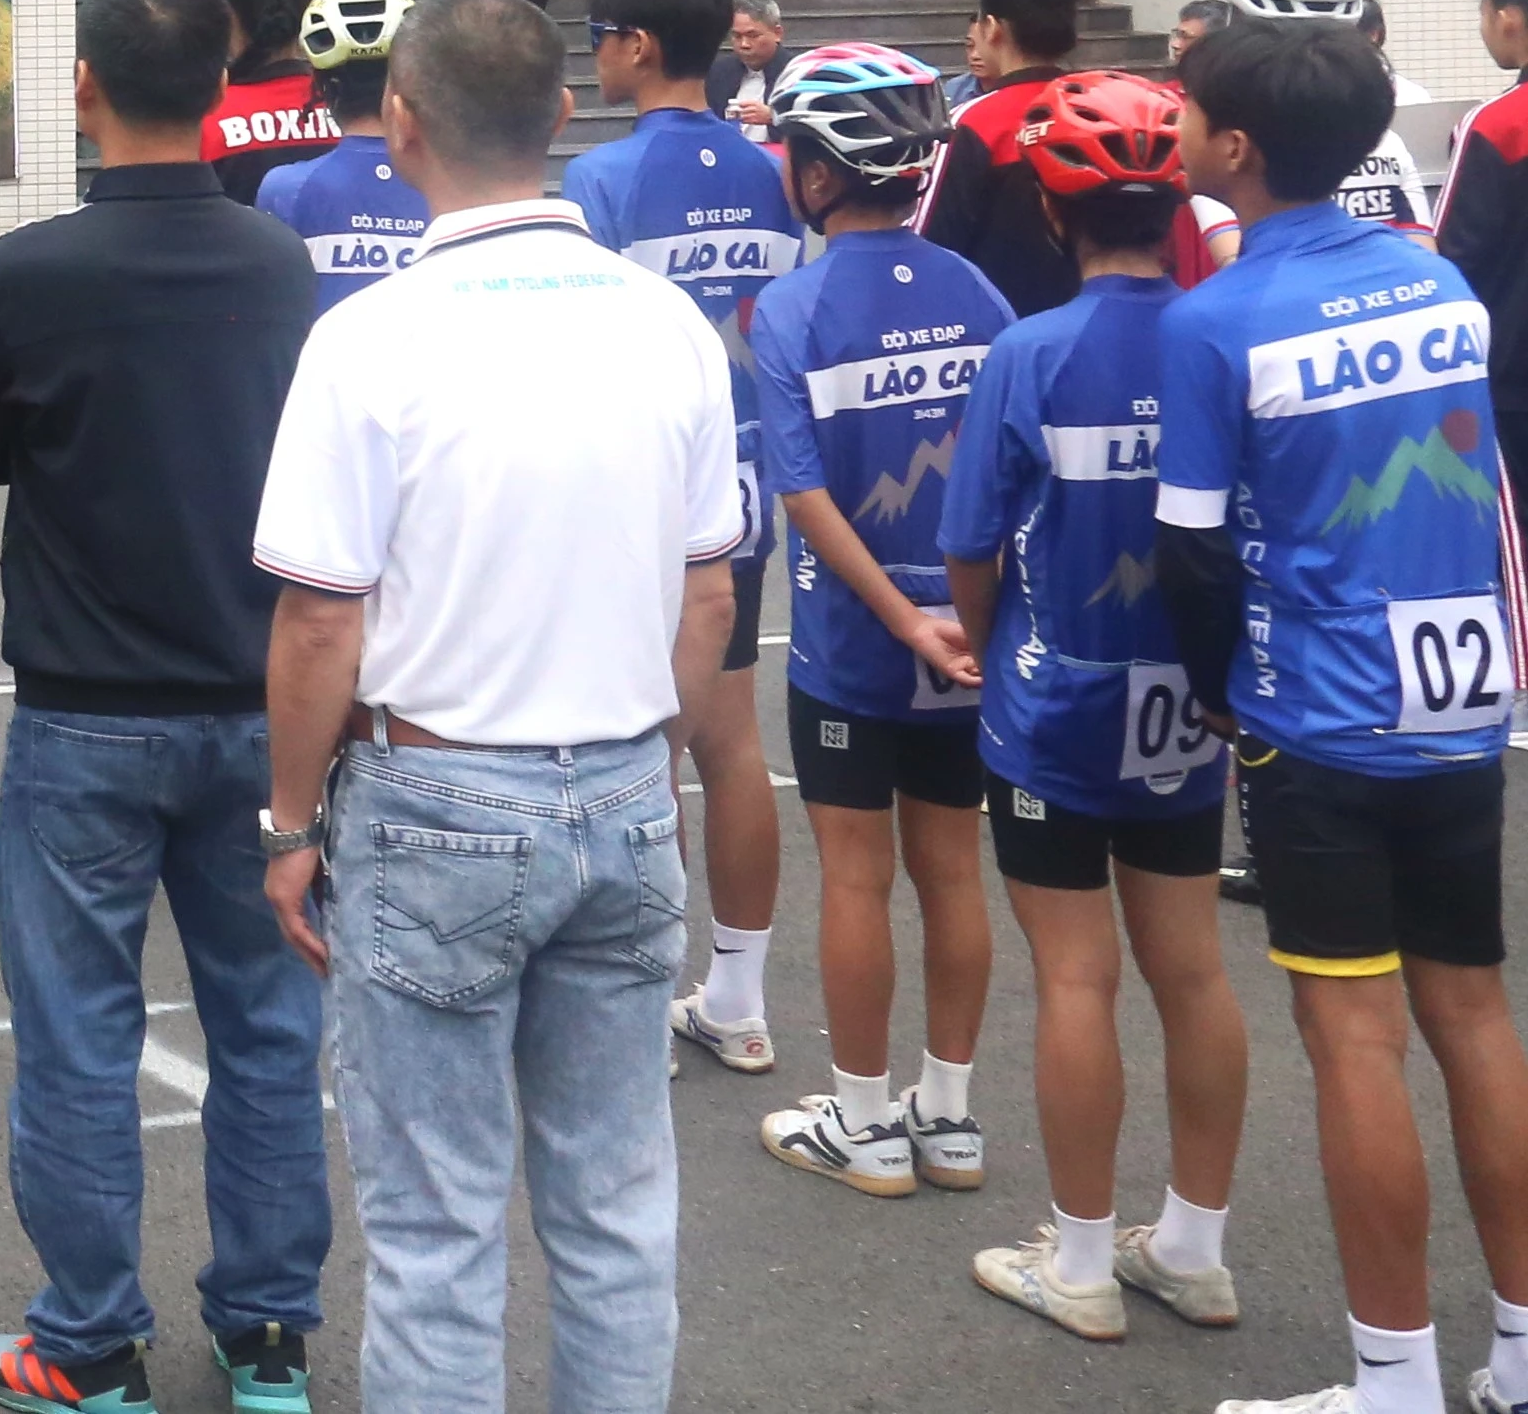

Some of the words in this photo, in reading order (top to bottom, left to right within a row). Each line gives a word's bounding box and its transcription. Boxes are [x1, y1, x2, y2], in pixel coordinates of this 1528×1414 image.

[219, 107, 343, 148] BOXIN
[375, 217, 393, 231] XE
[706, 209, 721, 224] XE
[332, 238, 389, 268] LÀO
[725, 242, 769, 271] CAI
[1320, 295, 1360, 318] ĐỘI
[1363, 290, 1392, 310] XE
[1394, 279, 1439, 302] ĐẠP
[881, 330, 907, 350] ĐỘI
[909, 328, 932, 345] XE
[932, 324, 966, 345] ĐẠP
[864, 361, 928, 403] LÀO
[1298, 337, 1402, 401] LÀO
[1132, 396, 1159, 419] ĐỘ
[1108, 429, 1160, 471] LÀ
[1248, 603, 1278, 699] TEAM
[1412, 618, 1501, 713] 02
